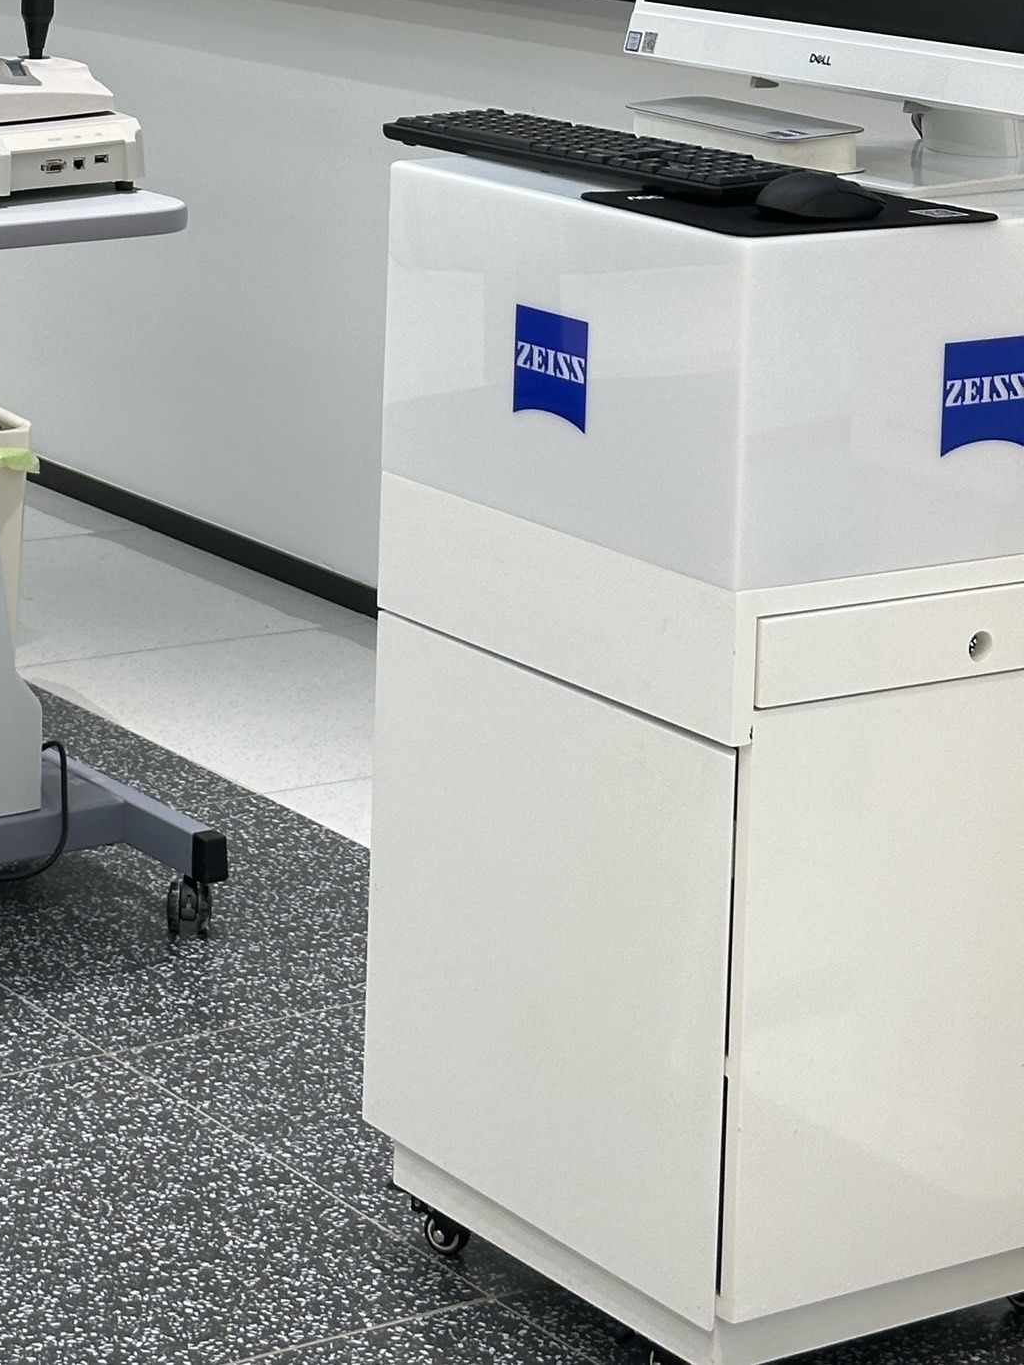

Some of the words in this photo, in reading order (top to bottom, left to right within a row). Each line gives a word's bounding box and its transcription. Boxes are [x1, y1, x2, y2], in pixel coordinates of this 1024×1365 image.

[809, 53, 831, 66] DELL
[516, 340, 585, 385] ZEISS
[945, 372, 1024, 408] ZEISS
